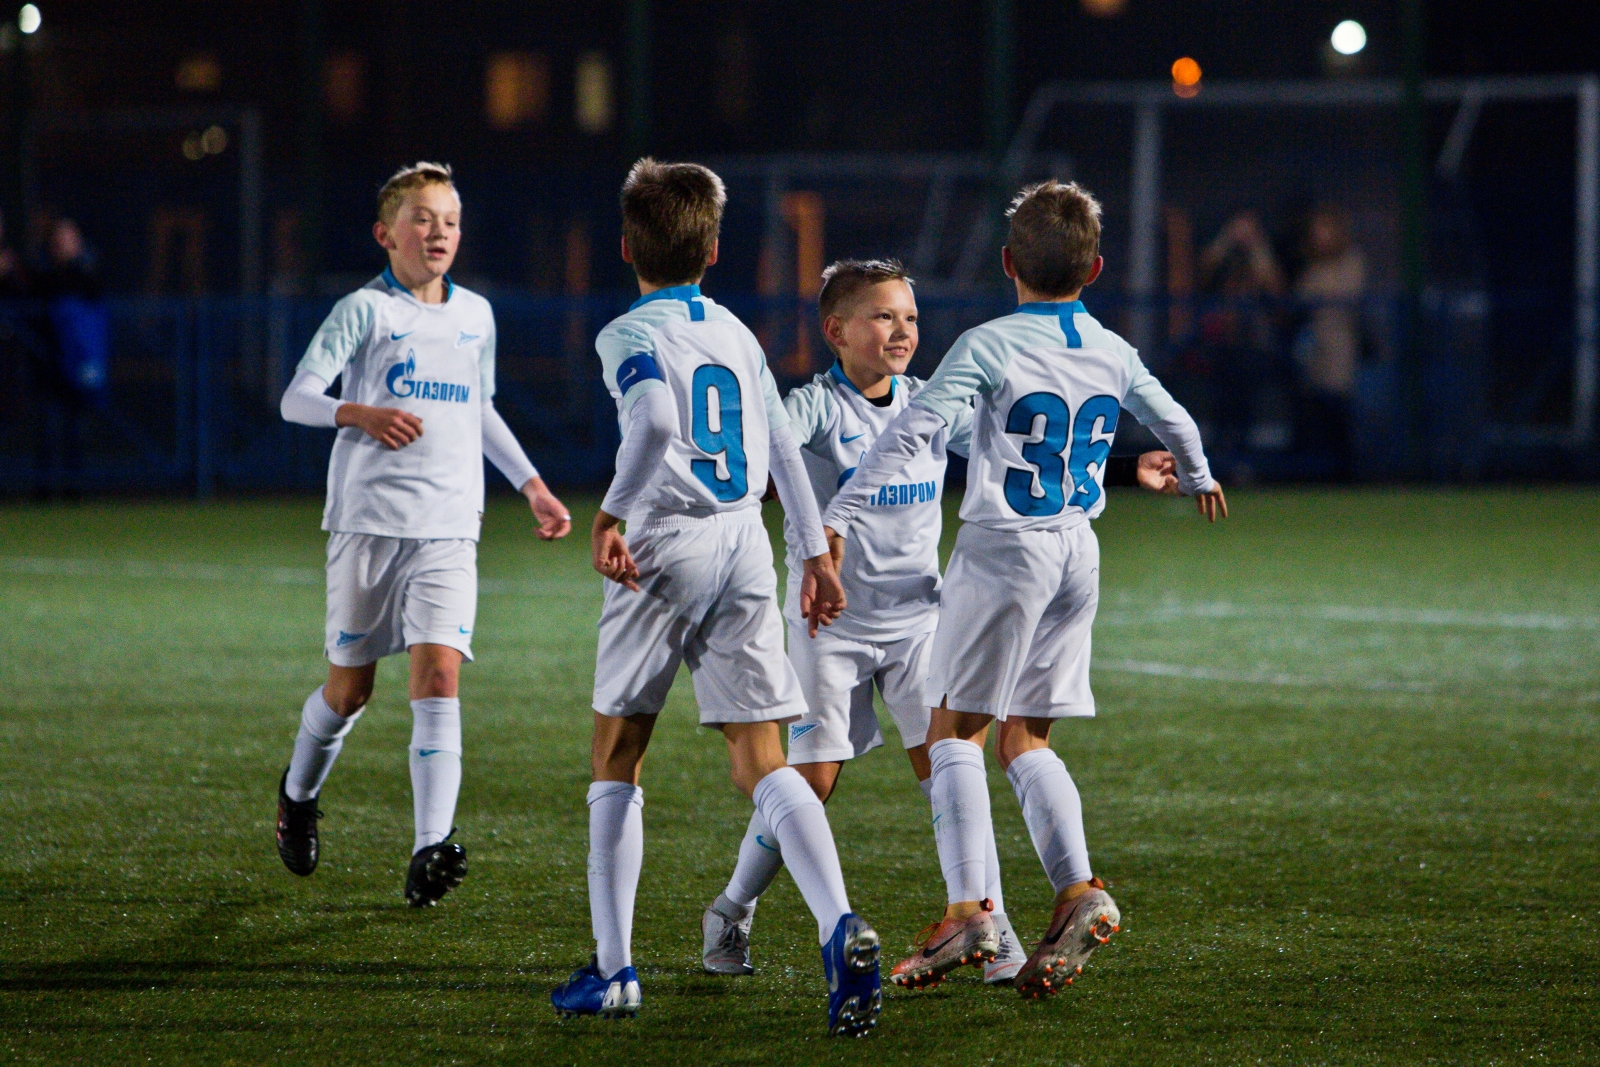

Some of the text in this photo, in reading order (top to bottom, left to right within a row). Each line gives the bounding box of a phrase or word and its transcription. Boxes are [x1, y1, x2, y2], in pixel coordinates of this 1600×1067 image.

[415, 380, 470, 403] ГАЗПРОМ
[691, 364, 748, 503] 9
[1003, 391, 1120, 517] 36
